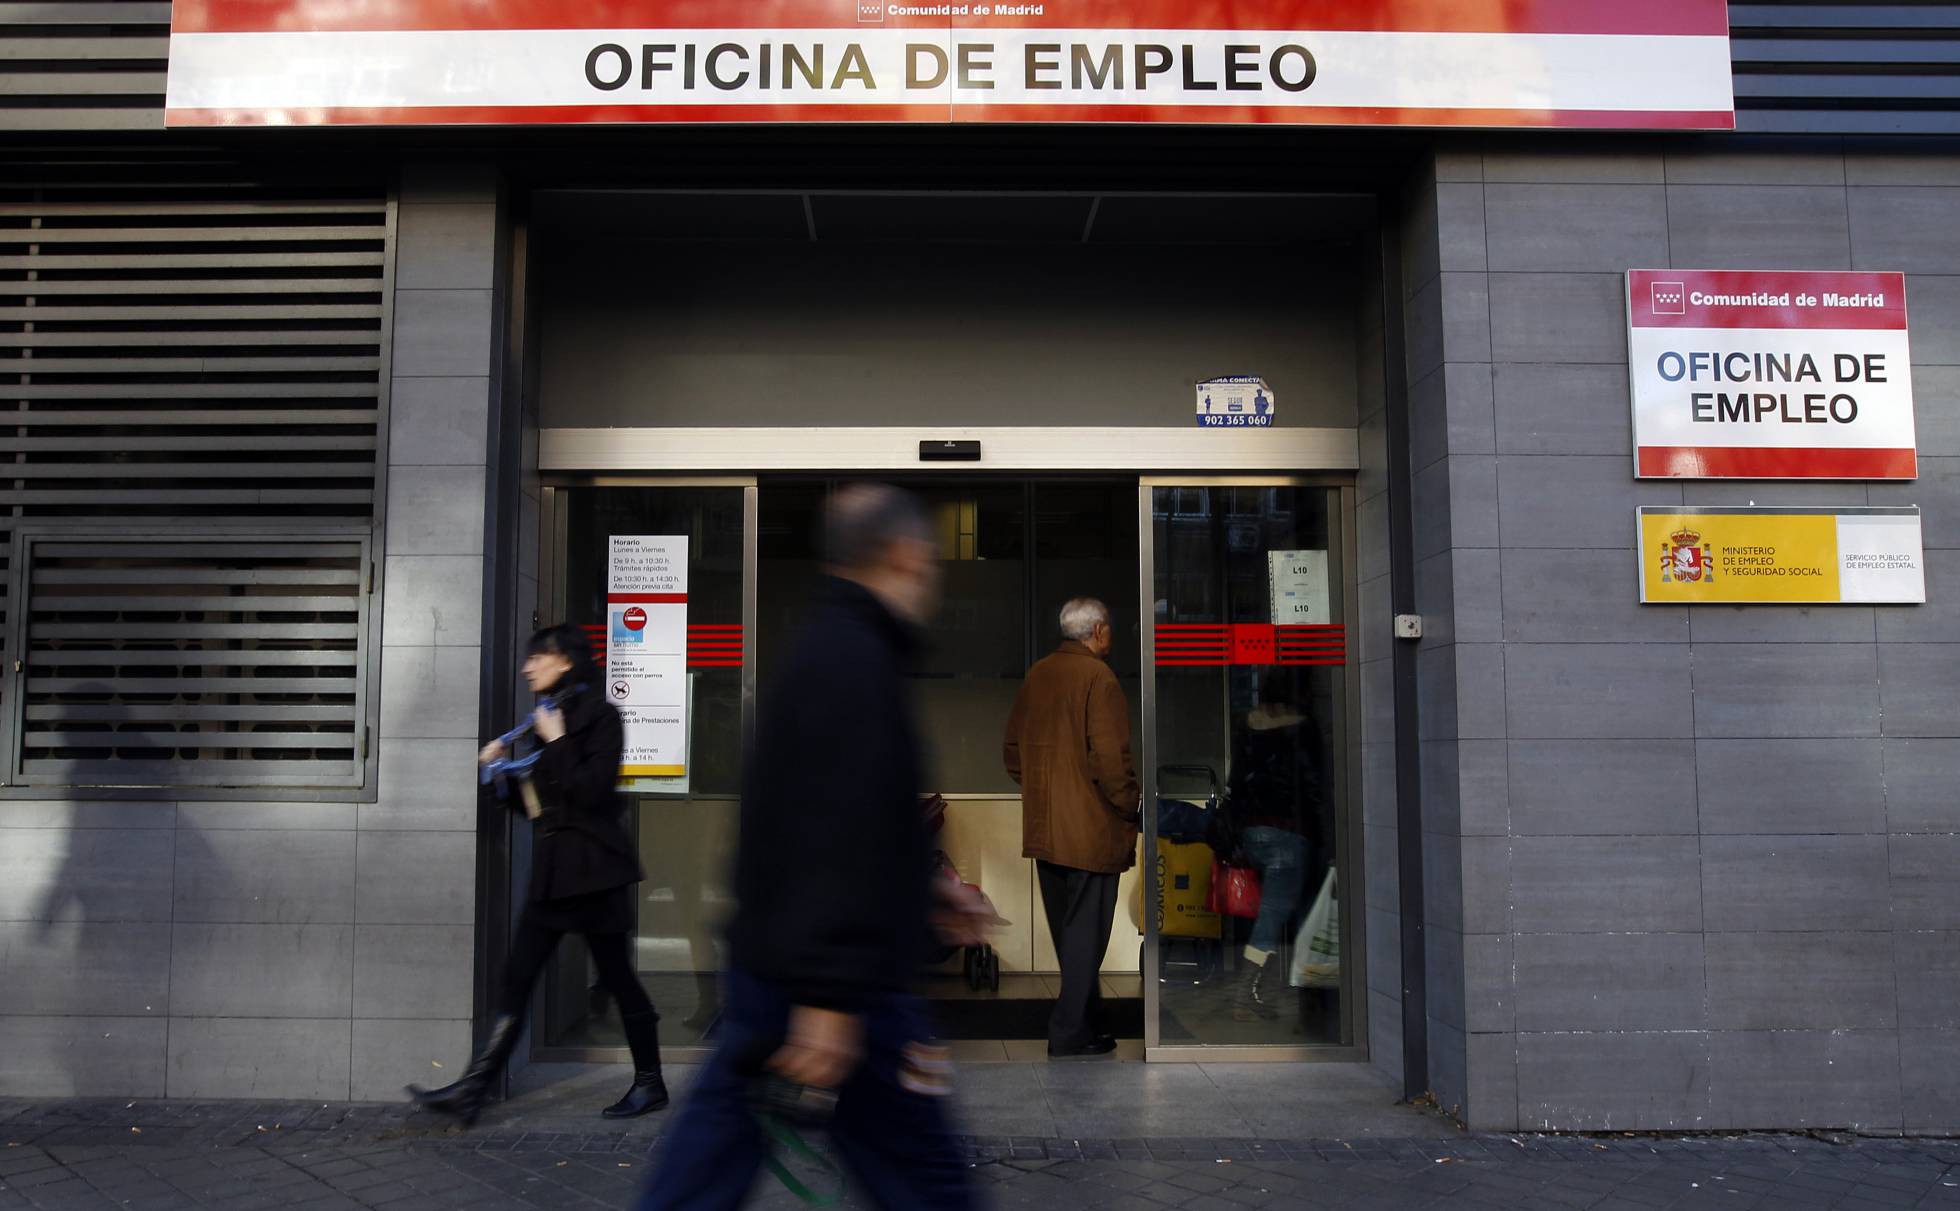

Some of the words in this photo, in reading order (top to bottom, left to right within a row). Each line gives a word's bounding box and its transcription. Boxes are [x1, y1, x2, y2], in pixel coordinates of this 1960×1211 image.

[888, 4, 968, 16] Comunidad
[973, 4, 990, 16] de
[994, 4, 1043, 16] Madrid
[584, 42, 877, 92] OFICINA
[905, 43, 996, 90] DE
[1025, 42, 1318, 92] EMPLEO
[1690, 292, 1790, 306] Comunidad
[1796, 292, 1817, 306] de
[1823, 293, 1884, 308] Madrid
[1657, 351, 1822, 382] OFICINA
[1834, 354, 1887, 382] DE
[1691, 393, 1858, 424] EMPLEO
[1204, 416, 1224, 425] 902
[1226, 416, 1245, 425] 365
[1248, 416, 1266, 425] 060
[1722, 547, 1775, 555] MINISTERIO
[1732, 568, 1786, 576] SEGURIDAD
[1788, 568, 1822, 576] SOCIAL
